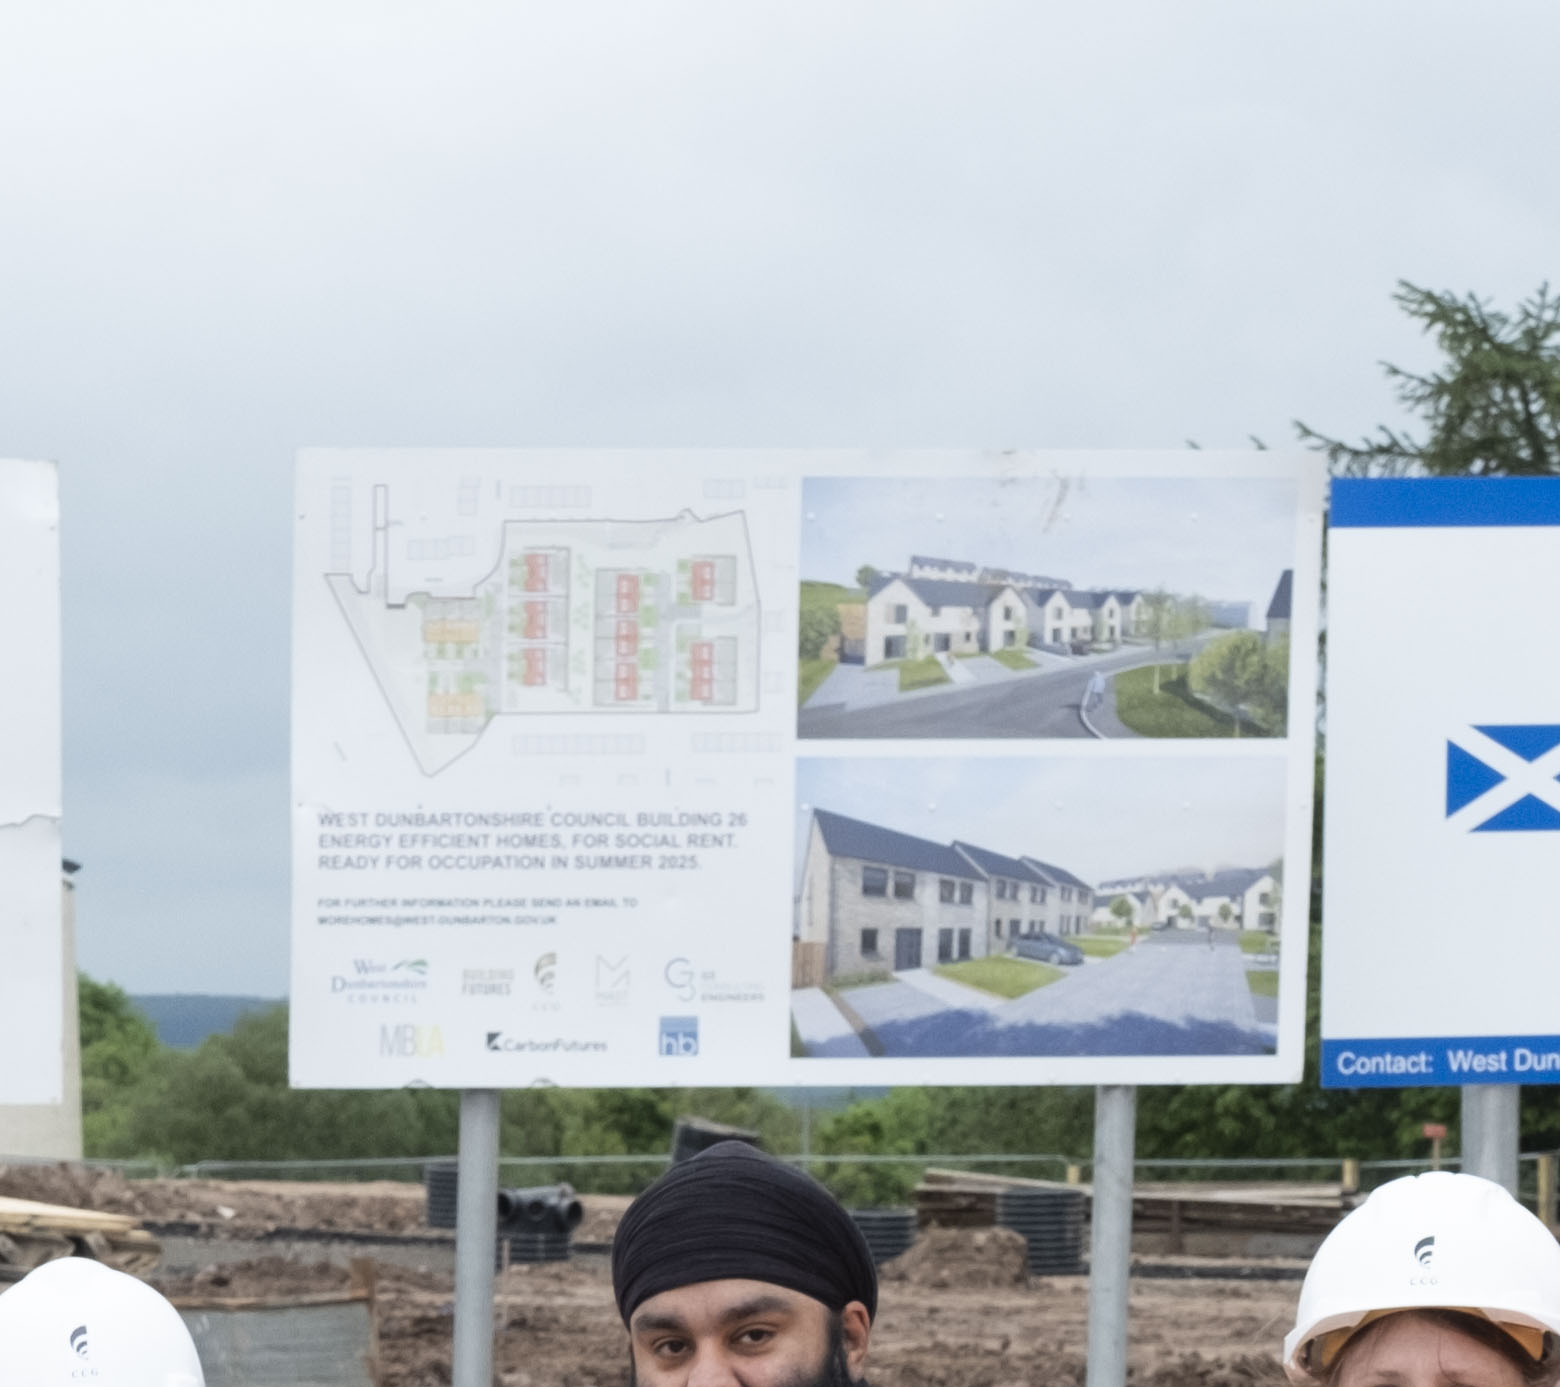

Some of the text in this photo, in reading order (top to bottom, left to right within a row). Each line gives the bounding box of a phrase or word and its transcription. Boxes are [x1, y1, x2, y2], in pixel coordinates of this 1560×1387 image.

[318, 812, 748, 827] WEST DUNBARTONSHIRE COUNCIL BUILDING 26
[318, 833, 392, 848] ENERGY
[398, 833, 490, 848] EFFICIENT
[572, 833, 609, 848] FOR
[615, 833, 680, 848] SOCIAL
[318, 855, 380, 869] READY
[385, 855, 423, 869] FOR
[428, 855, 545, 869] OCCUPATION
[550, 855, 569, 869] IN
[574, 855, 653, 869] SUMMER
[1336, 1050, 1434, 1076] Contact:
[1447, 1049, 1508, 1073] West
